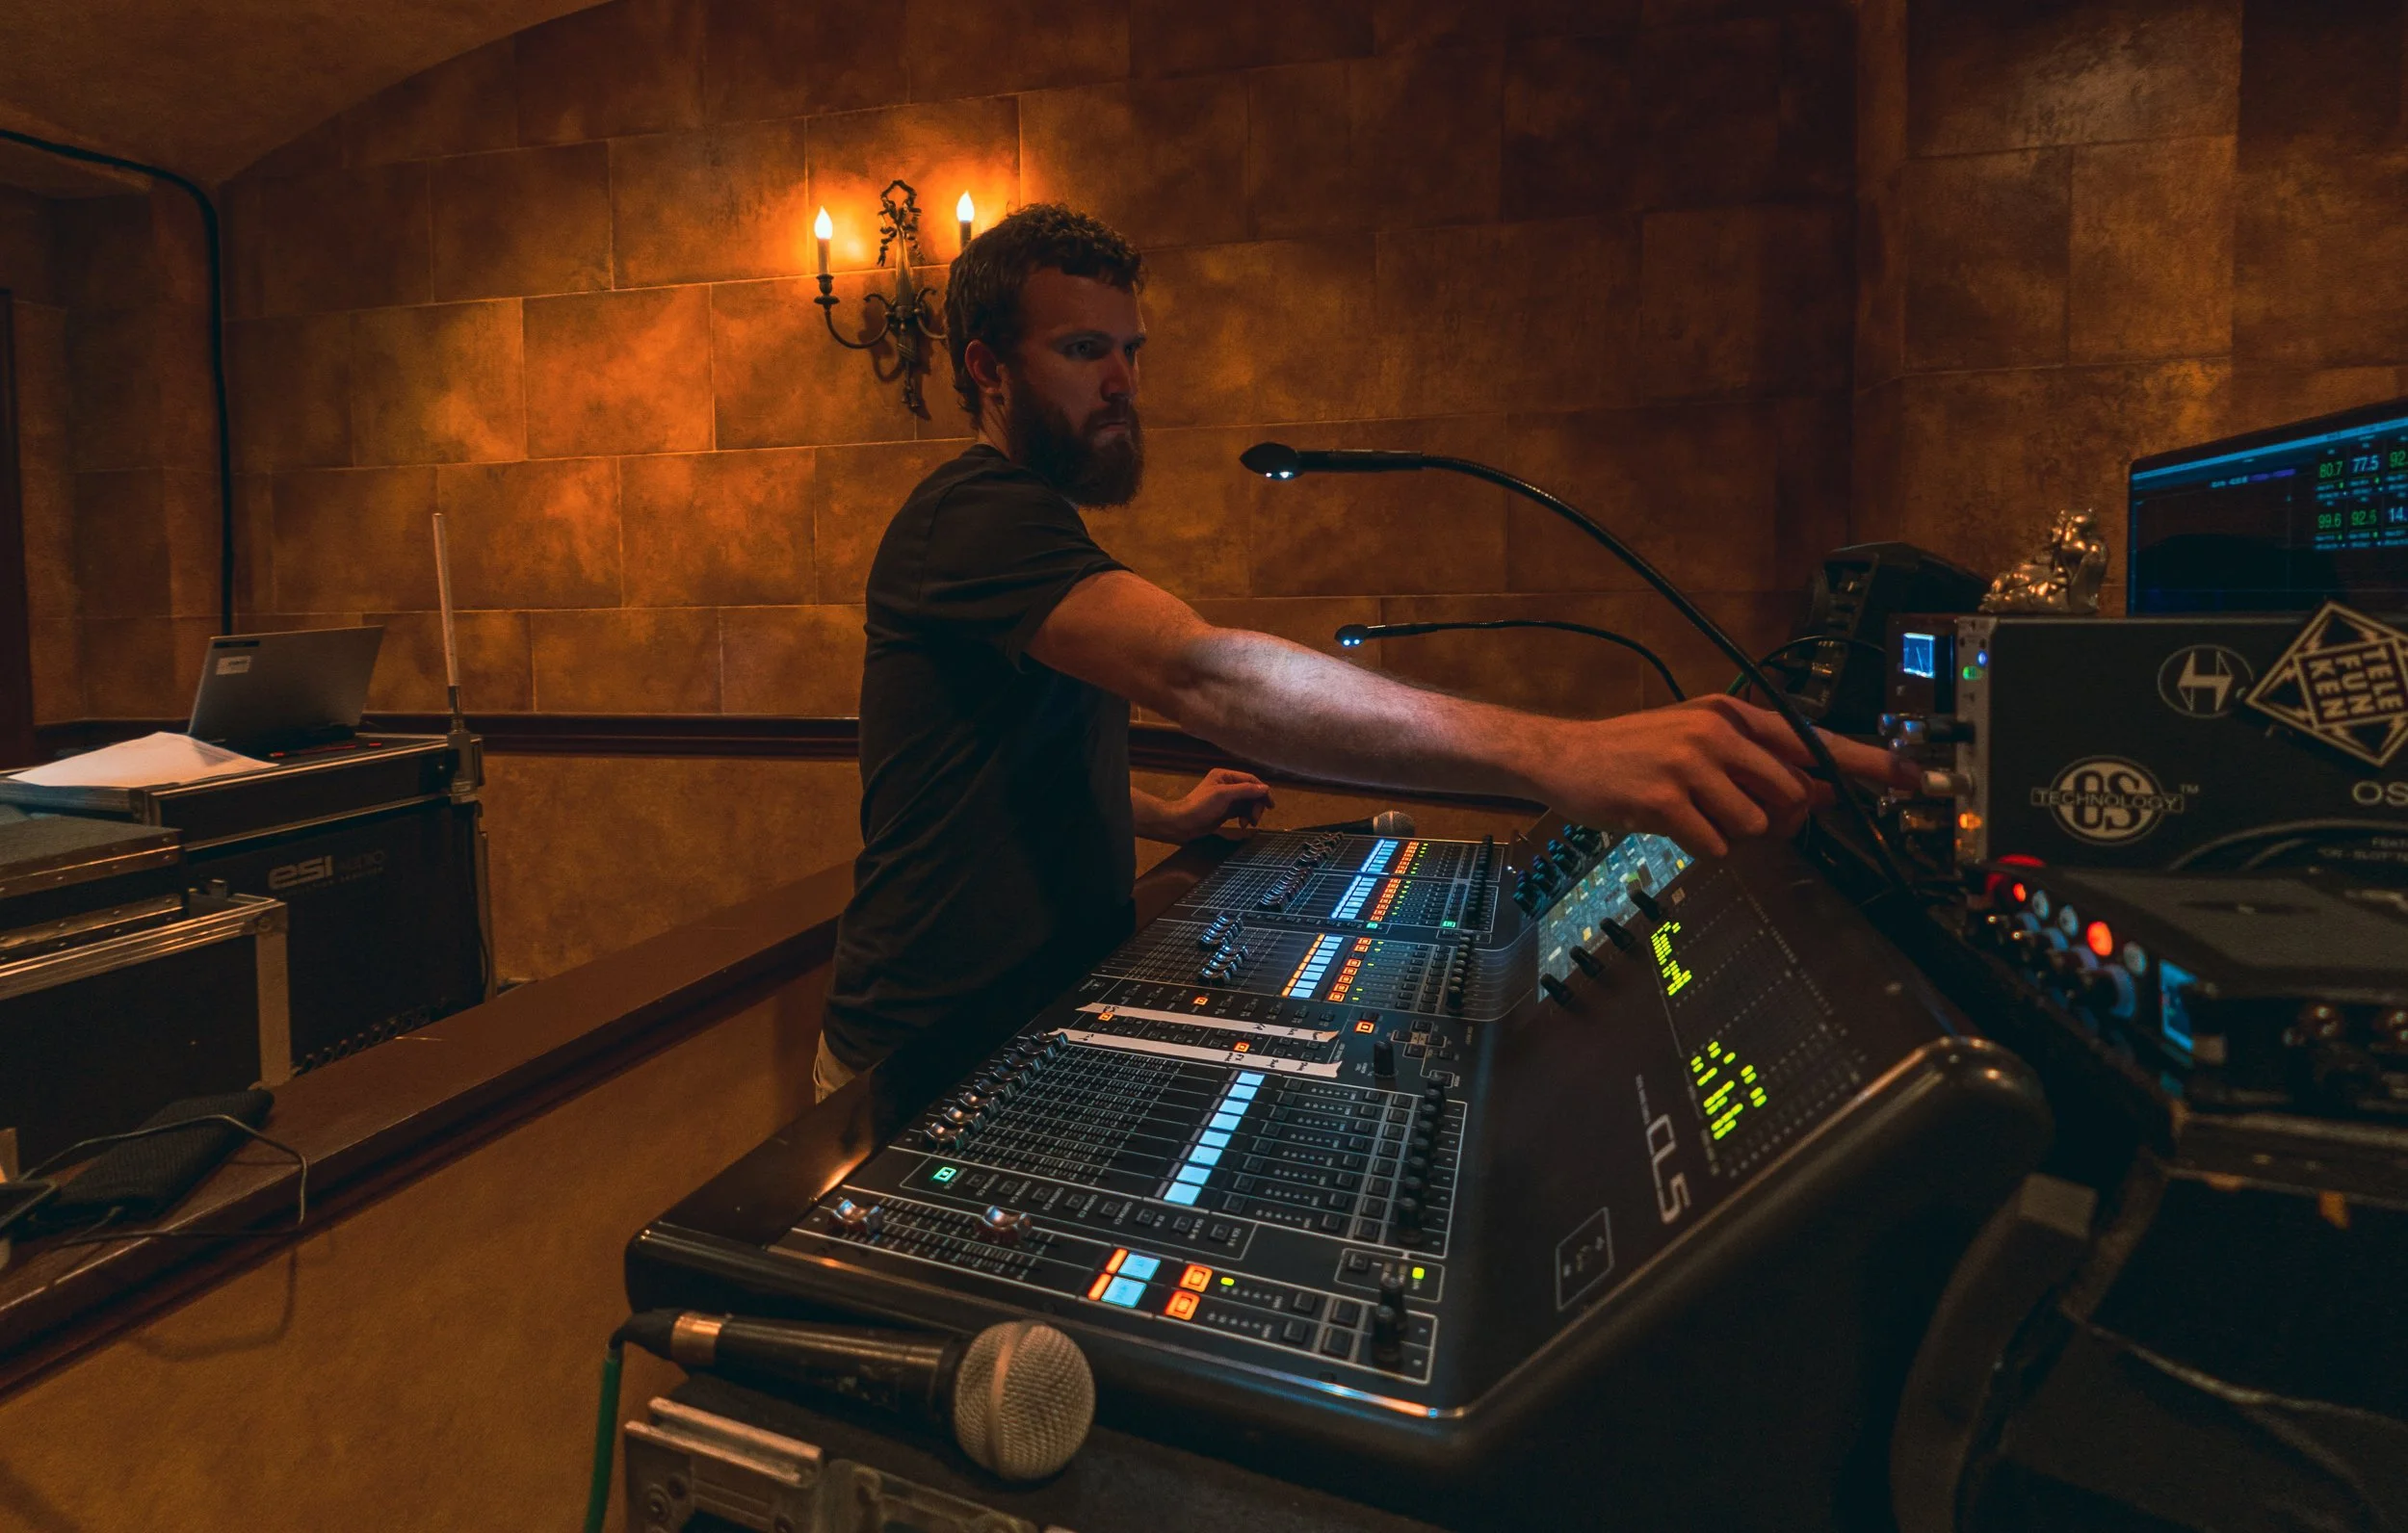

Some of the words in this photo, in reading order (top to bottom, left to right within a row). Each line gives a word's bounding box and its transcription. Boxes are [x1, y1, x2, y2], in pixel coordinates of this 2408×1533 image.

[2351, 454, 2379, 474] 77.5
[2308, 658, 2348, 720] KEN
[2335, 653, 2376, 715] FUN
[2362, 645, 2404, 711] TELE
[2037, 790, 2180, 811] TECHNOLOGY
